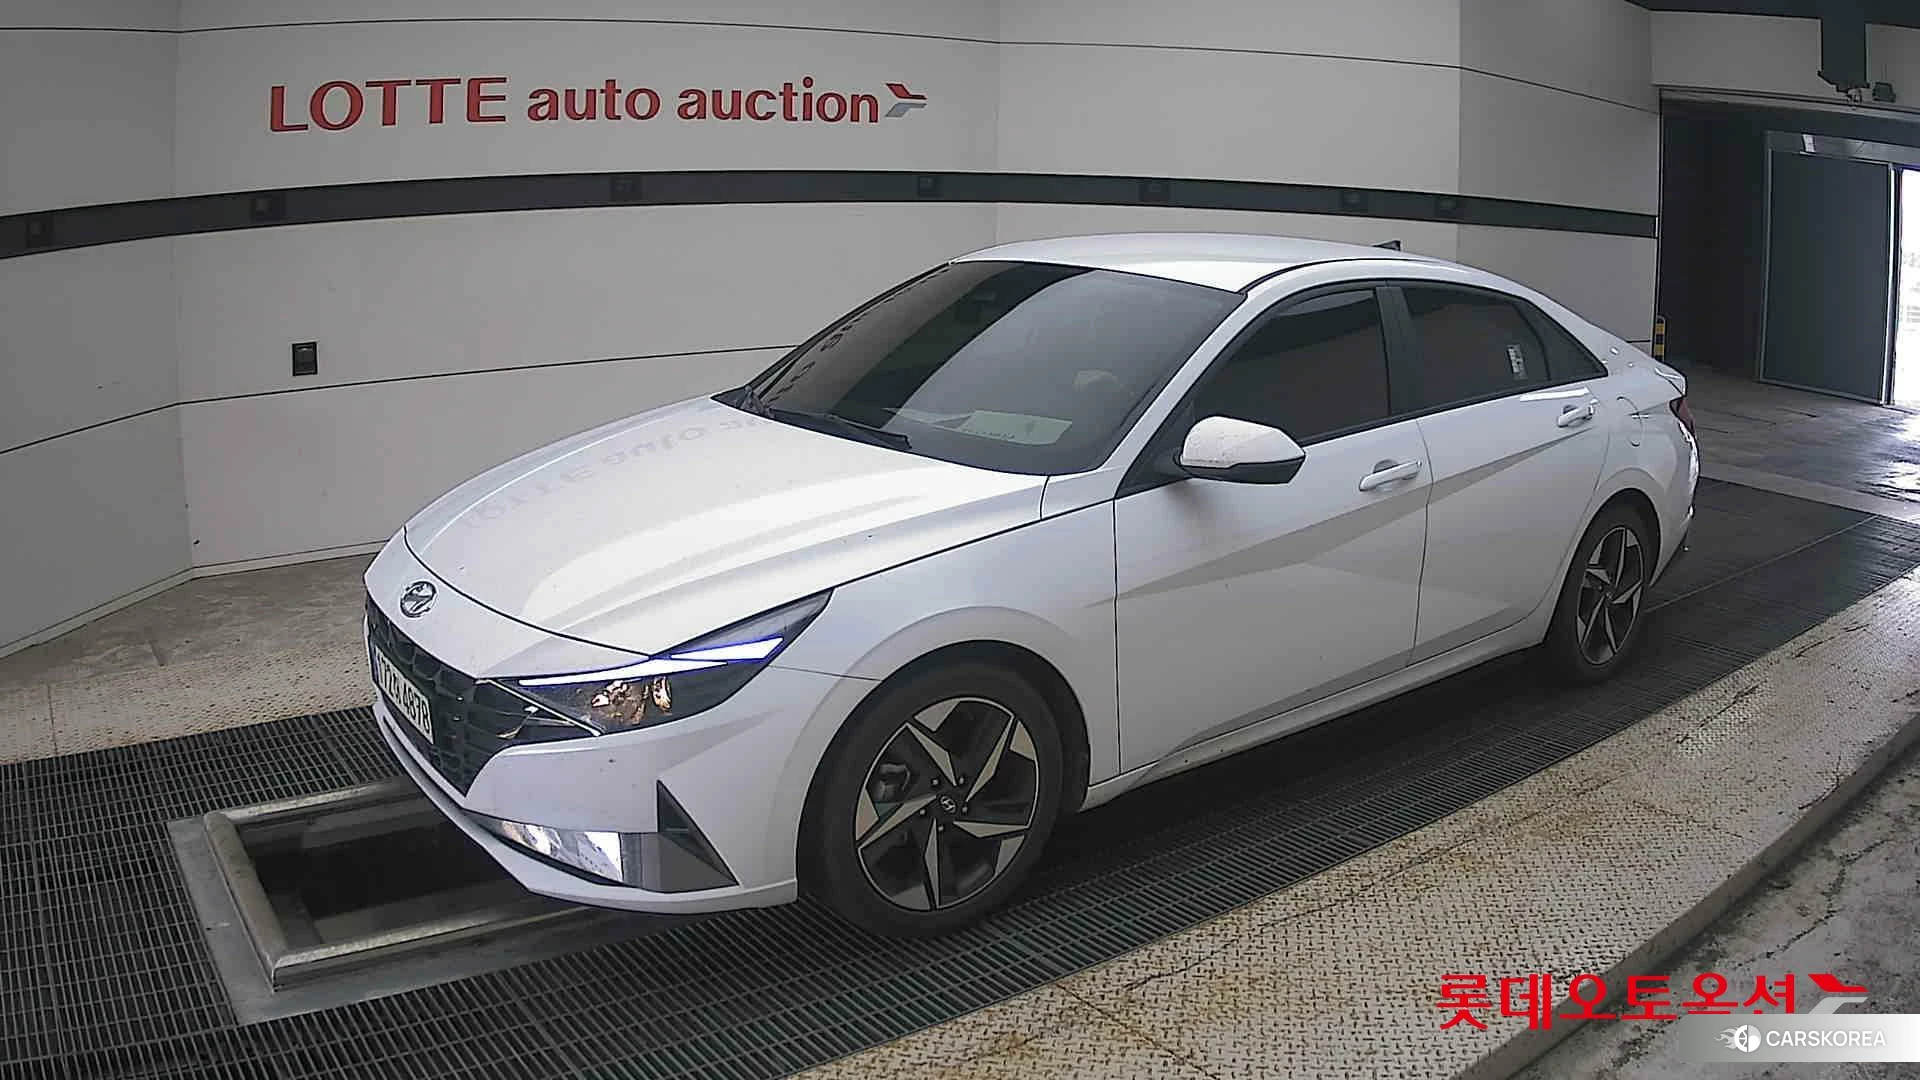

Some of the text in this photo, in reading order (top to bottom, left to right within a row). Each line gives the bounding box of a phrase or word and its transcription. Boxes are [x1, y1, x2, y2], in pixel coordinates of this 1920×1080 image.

[270, 76, 879, 132] LOTTE auto auction
